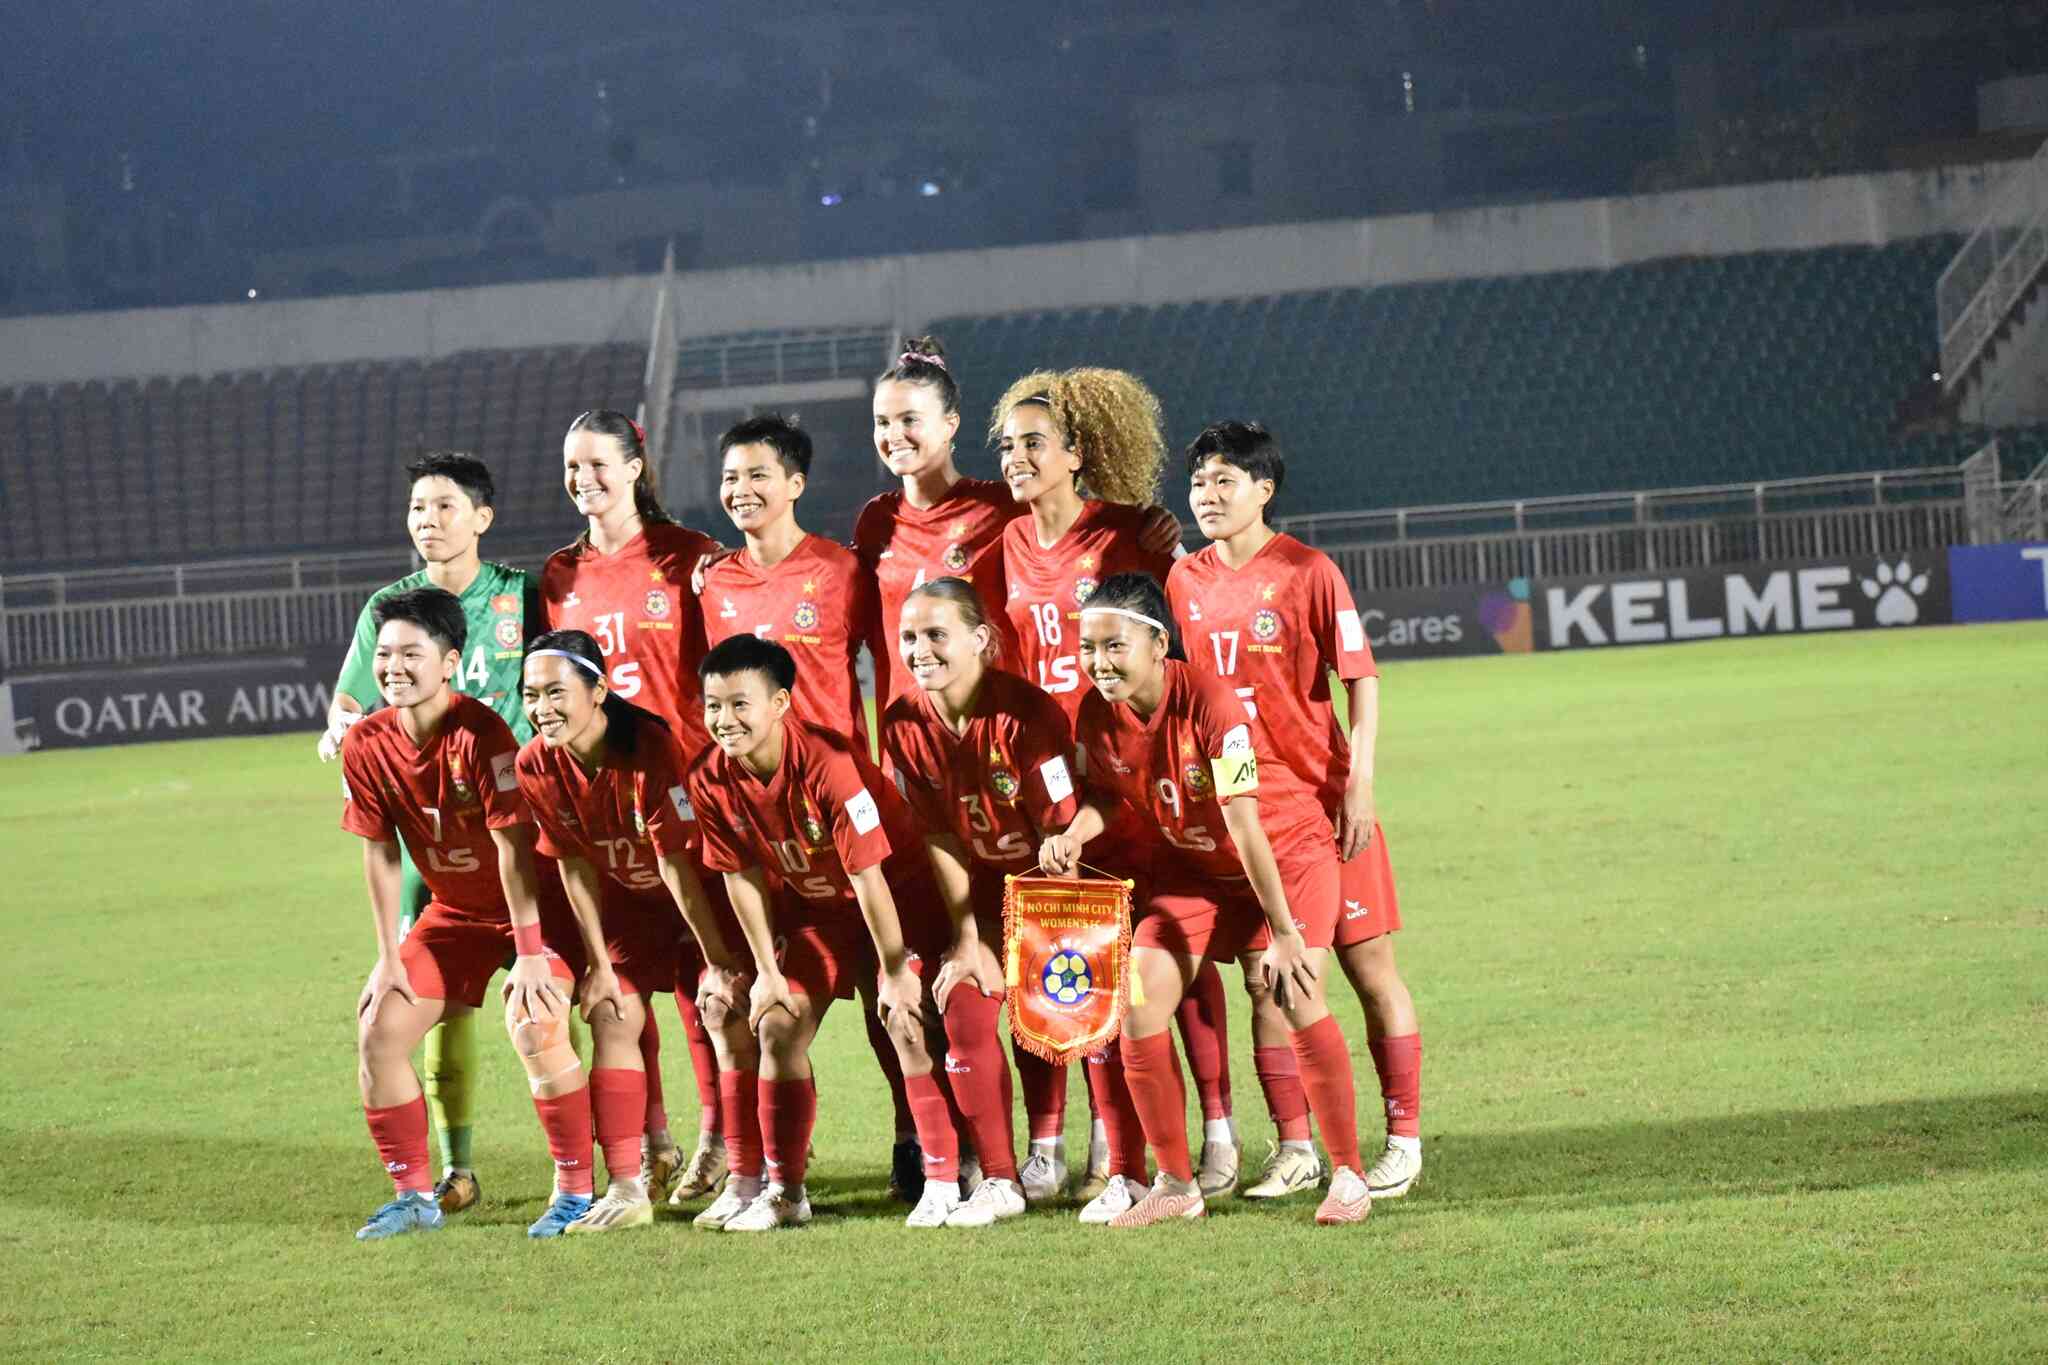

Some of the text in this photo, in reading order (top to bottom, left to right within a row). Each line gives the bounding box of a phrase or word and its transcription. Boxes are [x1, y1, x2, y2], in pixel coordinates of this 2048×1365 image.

[1029, 603, 1062, 646] 18
[1547, 567, 1854, 647] KELME
[592, 612, 626, 657] 31
[1360, 609, 1462, 646] Cares
[456, 645, 490, 691] 14
[1209, 630, 1240, 676] 17
[1038, 655, 1079, 694] LS
[55, 682, 331, 738] QATAR AIRW
[960, 795, 991, 832] 3
[1156, 778, 1180, 818] 9
[594, 837, 645, 869] 72
[770, 839, 810, 872] 10
[972, 832, 1031, 861] LS
[1160, 826, 1216, 852] LS
[425, 848, 481, 873] LS
[608, 870, 662, 891] LS
[781, 876, 836, 898] LS
[1043, 903, 1060, 913] CHI
[1062, 903, 1090, 914] MINH
[1091, 904, 1113, 914] CITY
